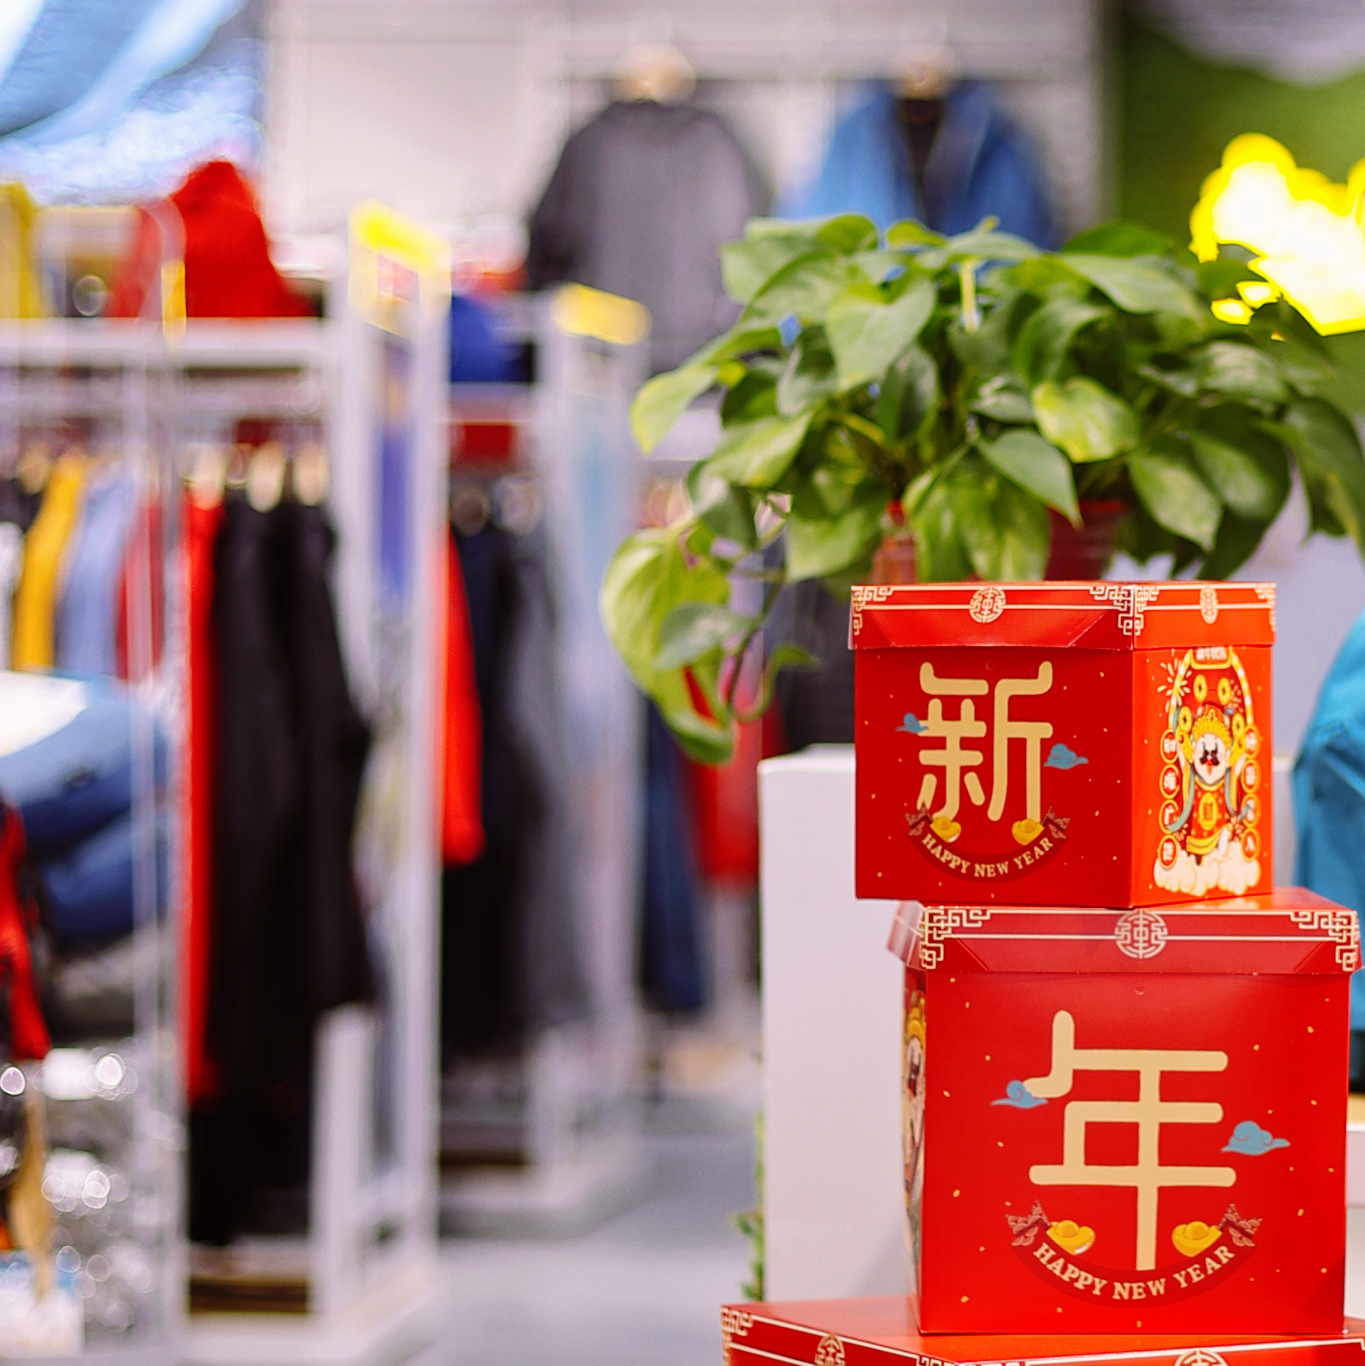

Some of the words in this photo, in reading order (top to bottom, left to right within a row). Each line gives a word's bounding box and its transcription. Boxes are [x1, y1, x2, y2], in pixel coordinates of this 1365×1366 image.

[917, 661, 1053, 824] 新
[922, 833, 970, 874] HAPPY
[974, 861, 1009, 877] NEW
[1013, 837, 1053, 869] YEAR
[1023, 1010, 1236, 1270] 年
[1033, 1242, 1107, 1295] HAPPY
[1112, 1278, 1166, 1300] NEW
[1173, 1245, 1235, 1288] YEAR
